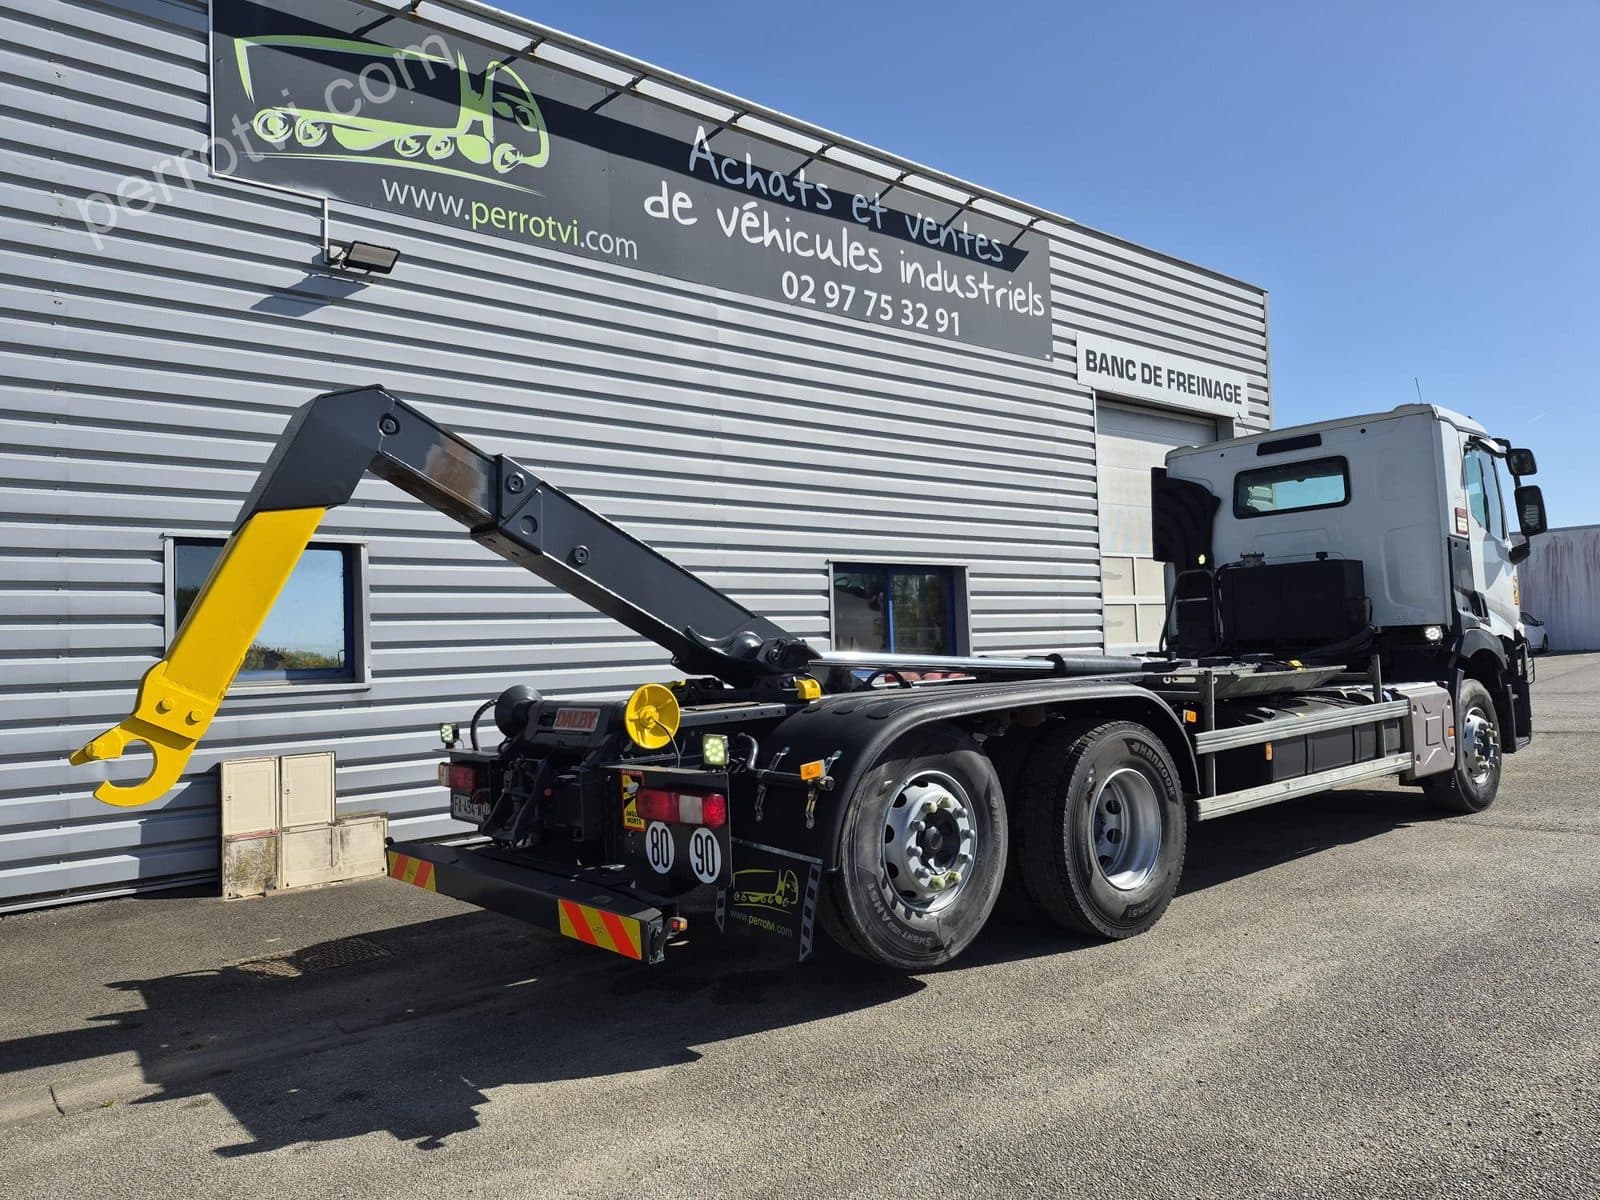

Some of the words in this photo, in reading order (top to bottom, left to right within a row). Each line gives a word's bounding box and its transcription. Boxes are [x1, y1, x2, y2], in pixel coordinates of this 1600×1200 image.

[381, 175, 639, 262] www.perrotvi.com
[689, 125, 833, 211] Achats
[852, 192, 888, 230] et
[905, 211, 1005, 263] ventes
[644, 180, 698, 226] de
[717, 200, 883, 274] véhicules
[899, 248, 1046, 318] industriels
[781, 271, 817, 305] 02
[823, 281, 856, 313] 97
[863, 290, 894, 320] 75
[901, 302, 930, 331] 32
[935, 309, 961, 337] 91
[1085, 348, 1137, 383] BANC
[1141, 361, 1164, 388] DE
[1166, 367, 1243, 405] FREINAGE
[650, 827, 670, 869] 80
[694, 833, 716, 877] 90
